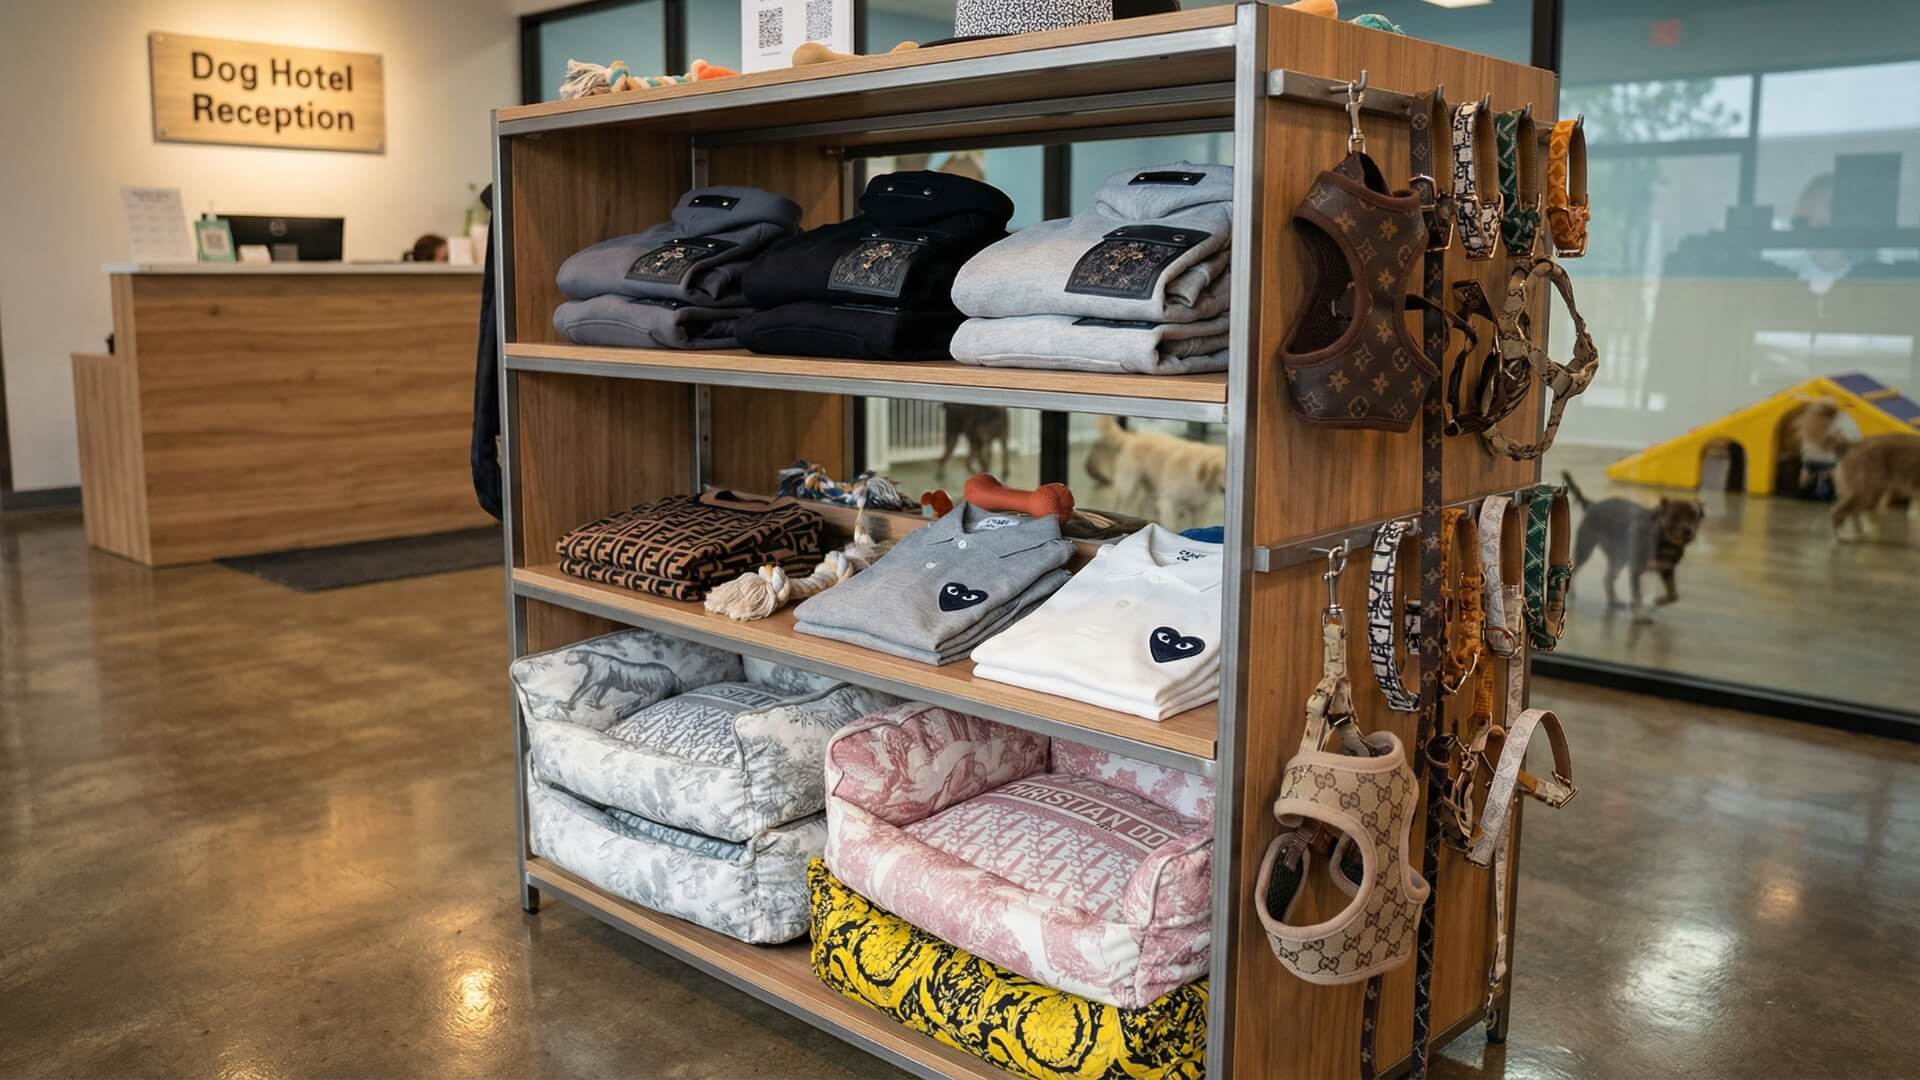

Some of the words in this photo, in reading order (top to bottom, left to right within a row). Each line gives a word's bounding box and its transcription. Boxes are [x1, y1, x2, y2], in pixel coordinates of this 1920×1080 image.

[192, 51, 257, 90] Dog
[271, 58, 353, 91] Hotel
[193, 93, 354, 133] Reception
